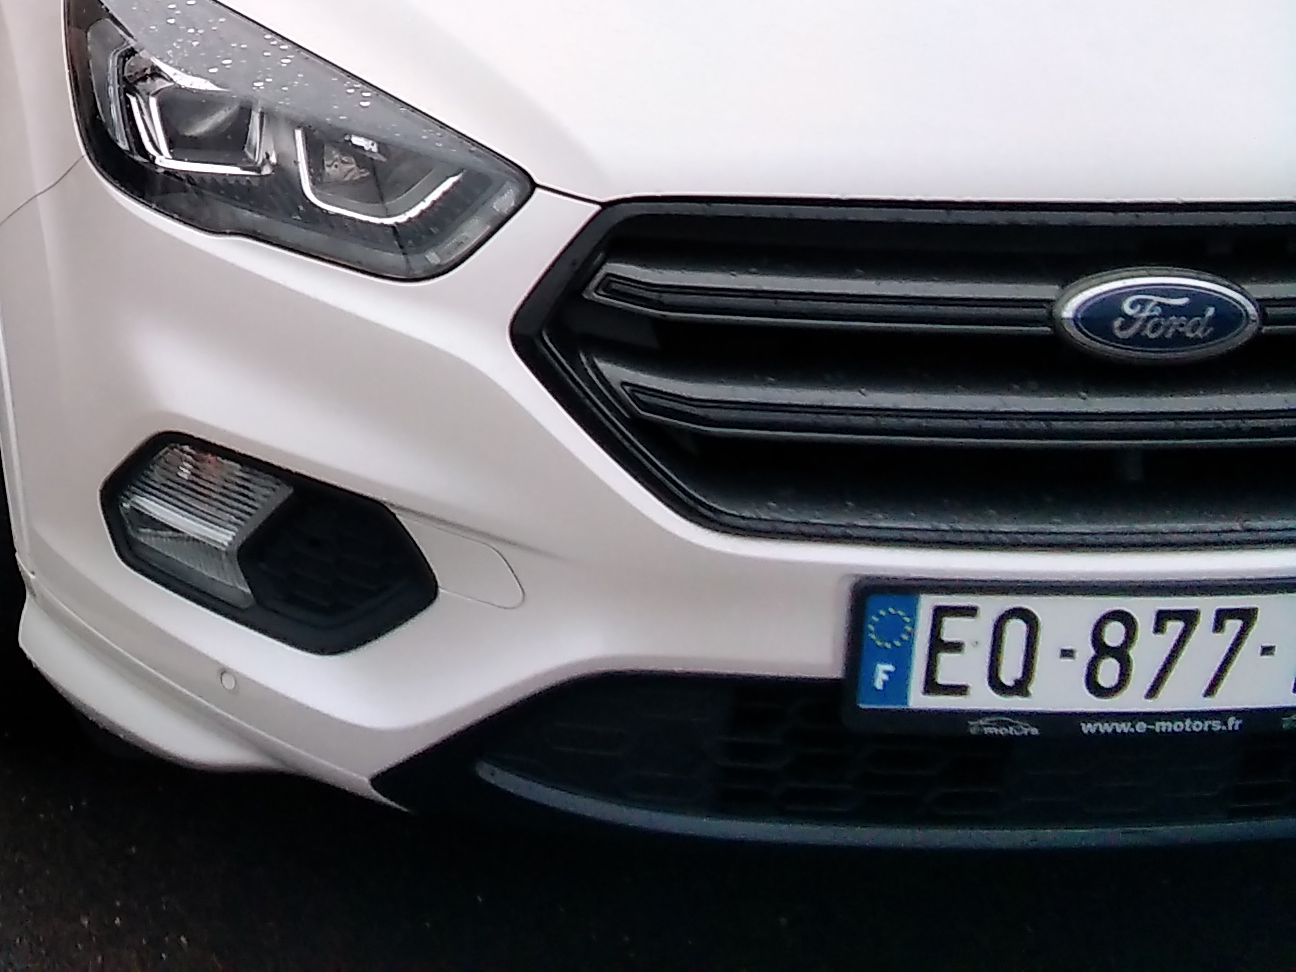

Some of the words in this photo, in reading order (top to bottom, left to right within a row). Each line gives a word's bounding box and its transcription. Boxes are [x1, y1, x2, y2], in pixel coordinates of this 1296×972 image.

[1112, 294, 1215, 340] Ford
[920, 605, 1296, 700] EQ-877-
[873, 663, 896, 691] F
[1081, 715, 1243, 734] www.e-motors.fr
